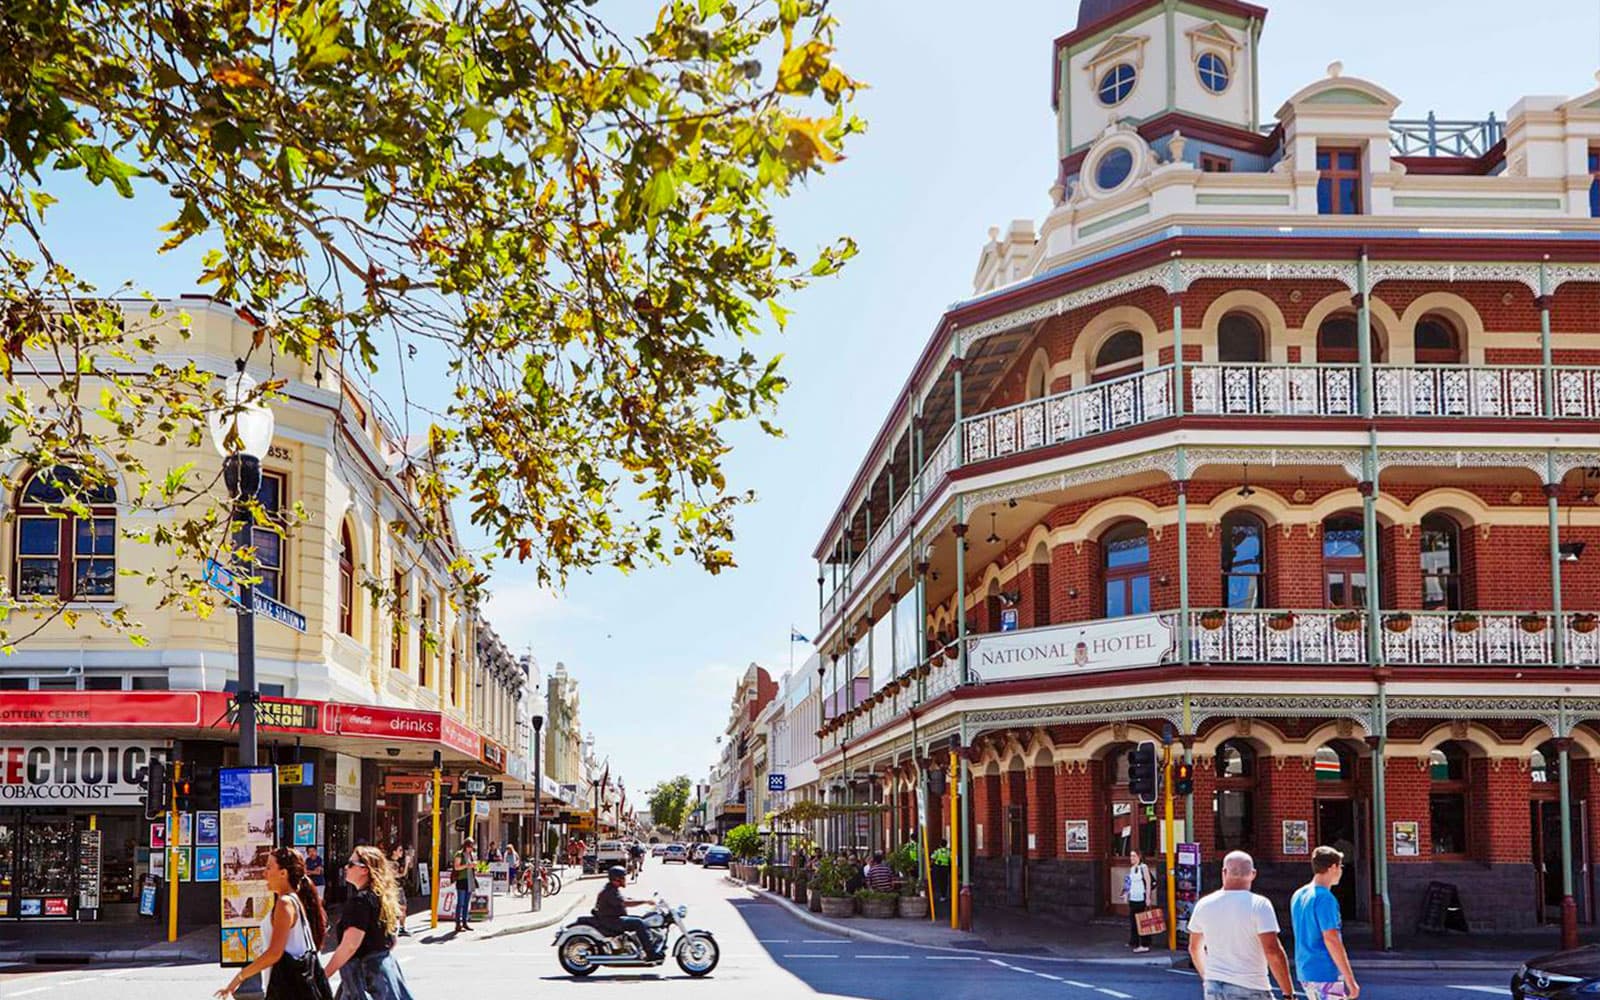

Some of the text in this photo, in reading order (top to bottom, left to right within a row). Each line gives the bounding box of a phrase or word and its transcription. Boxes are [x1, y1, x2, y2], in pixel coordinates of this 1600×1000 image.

[982, 632, 1157, 667] NATIONAL HOTEL
[0, 710, 90, 719] OTTERY CENTRE
[390, 716, 434, 733] drinks
